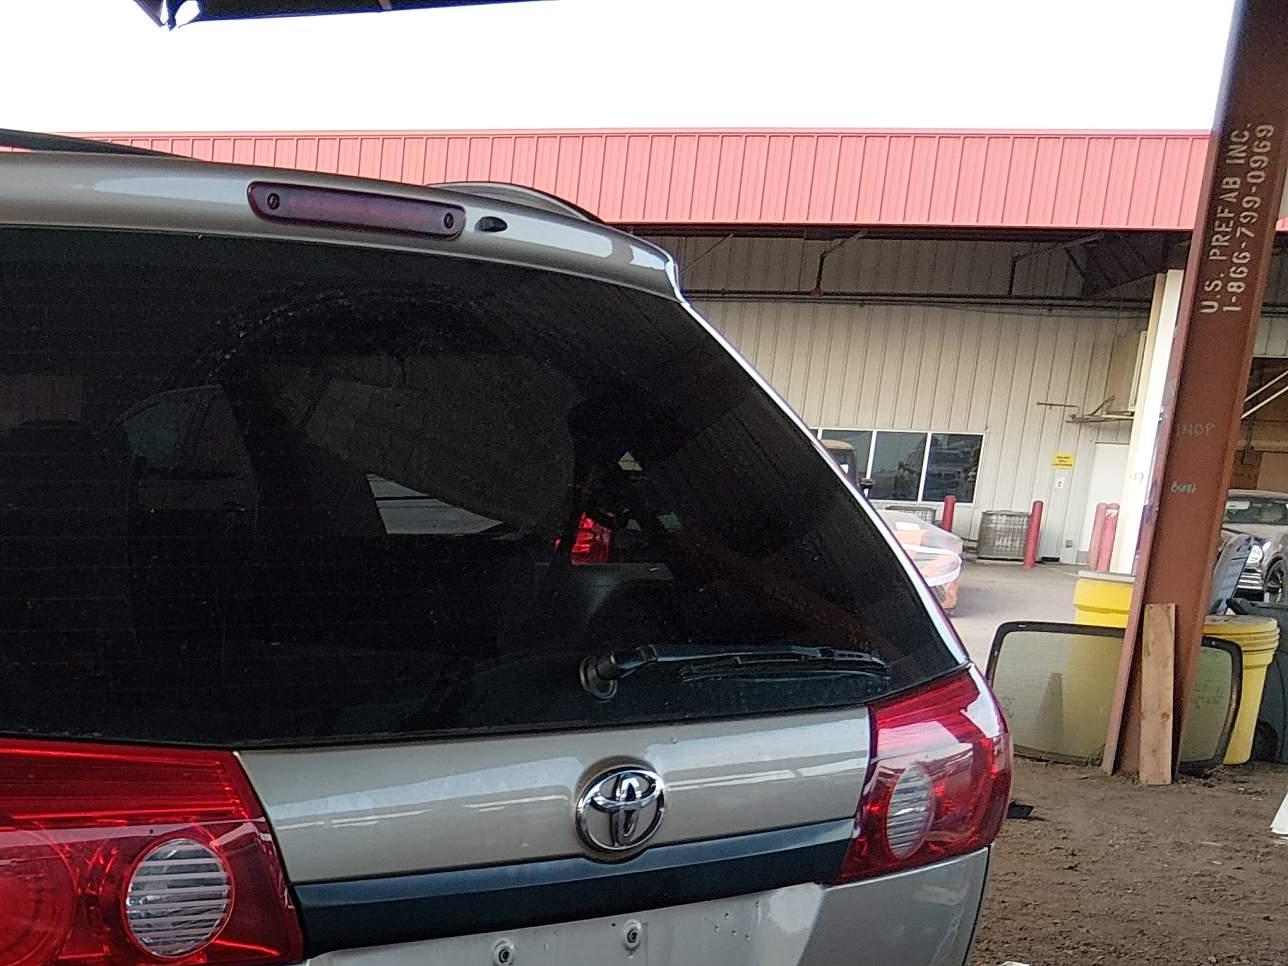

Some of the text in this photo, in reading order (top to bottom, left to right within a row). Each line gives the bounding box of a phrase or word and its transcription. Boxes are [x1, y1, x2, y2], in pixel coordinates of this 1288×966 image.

[1199, 122, 1252, 314] U.S. PREFAB INC.
[1222, 124, 1275, 312] 1-866-799-0969
